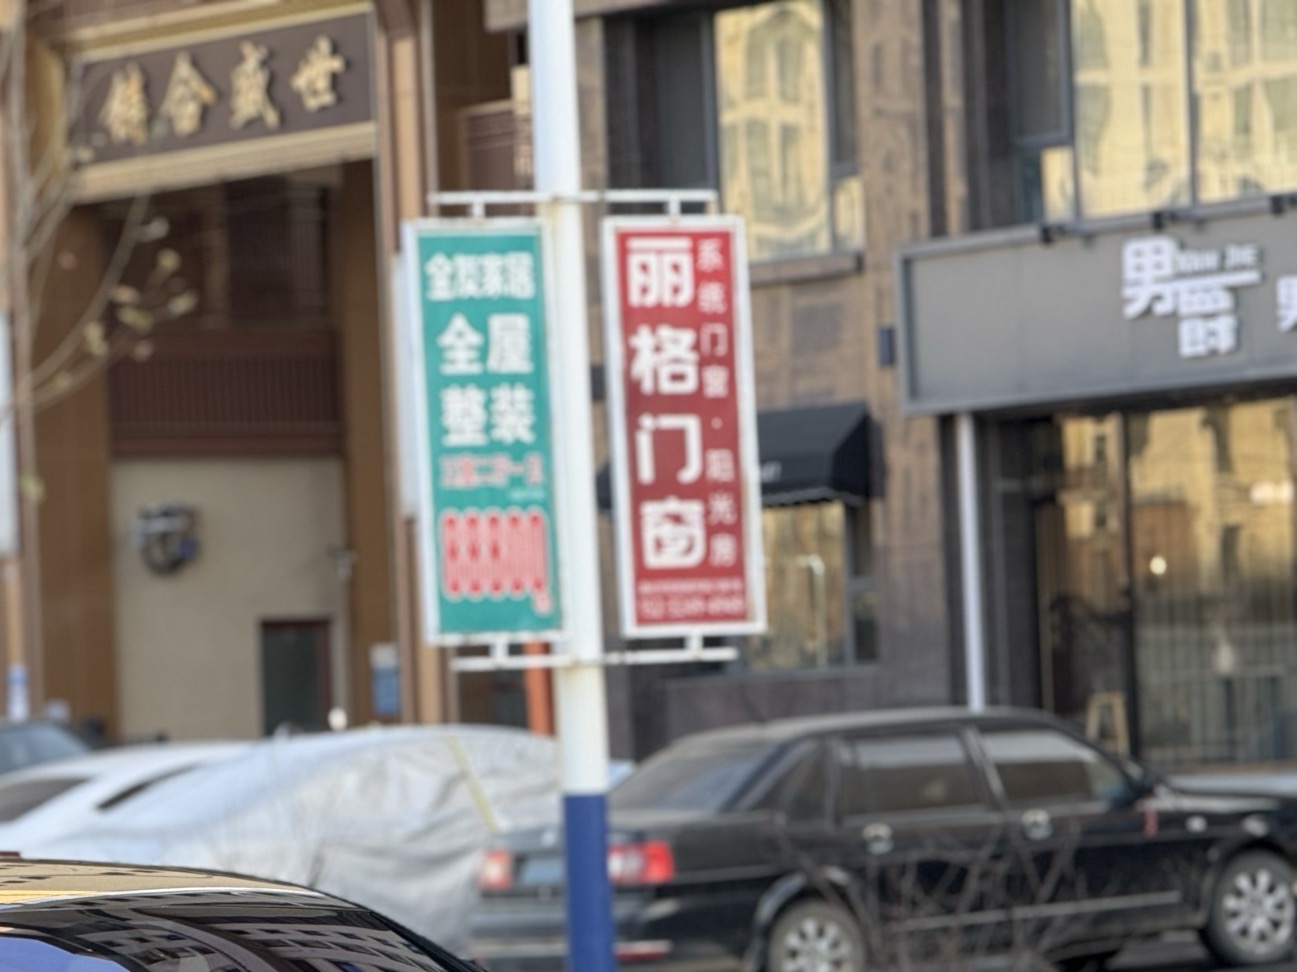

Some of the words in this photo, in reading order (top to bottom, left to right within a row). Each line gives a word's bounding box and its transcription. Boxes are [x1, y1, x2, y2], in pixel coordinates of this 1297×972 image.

[437, 313, 534, 375] 全屋
[440, 384, 536, 447] 整装
[626, 237, 705, 569] 丽格门窗
